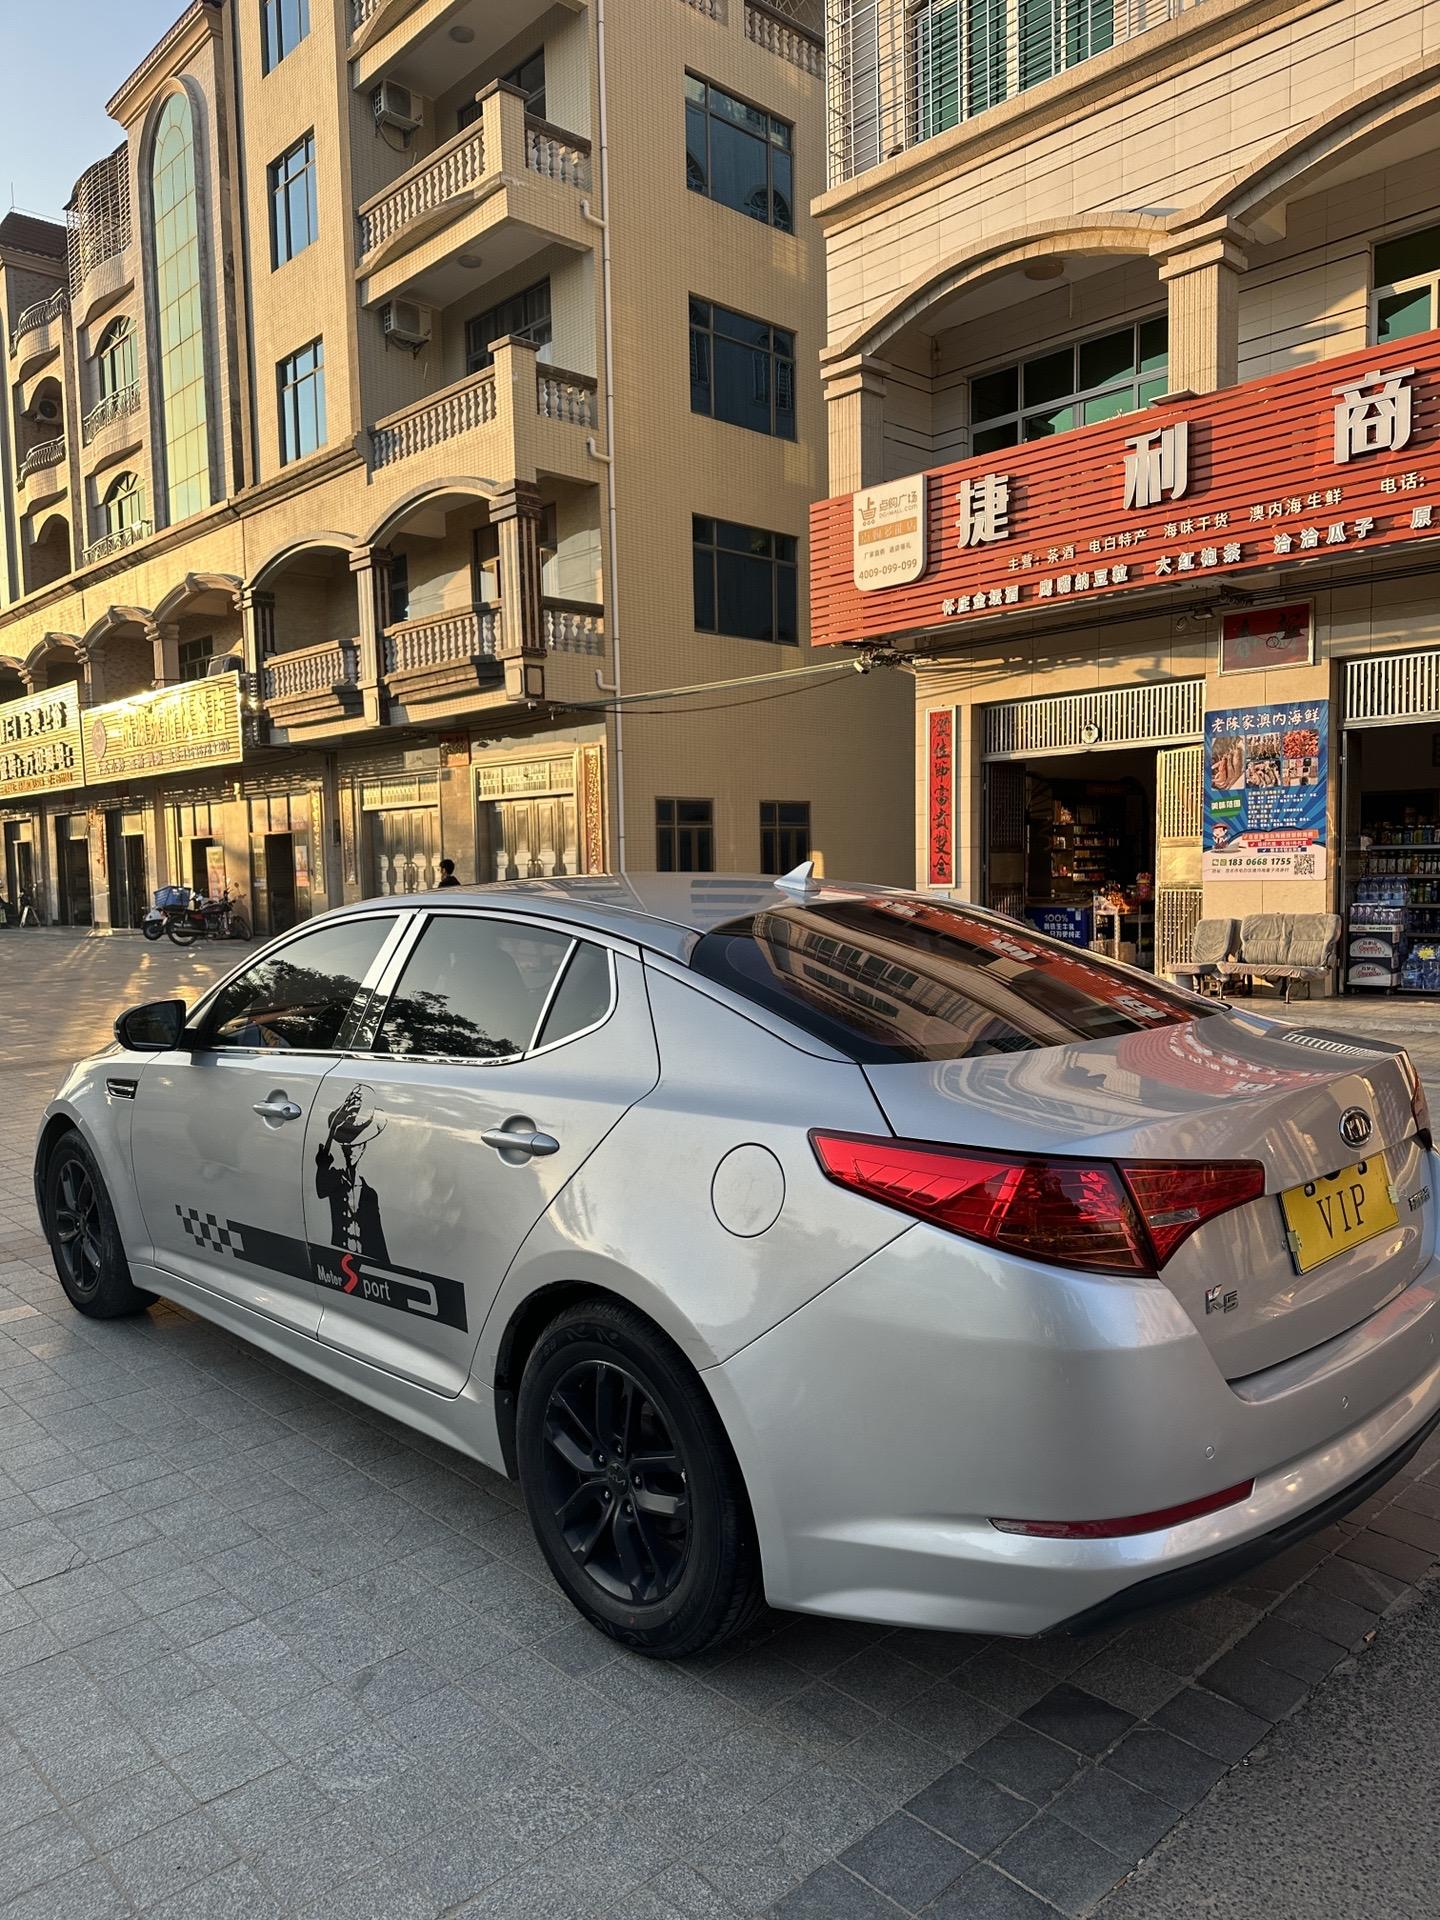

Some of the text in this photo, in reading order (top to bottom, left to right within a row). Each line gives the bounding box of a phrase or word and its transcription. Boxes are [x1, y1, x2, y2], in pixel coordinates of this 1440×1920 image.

[1089, 529, 1148, 554] 电白特产
[1163, 512, 1230, 539] 海味干货
[1249, 488, 1342, 523] 澳内海生鲜
[1155, 543, 1241, 576] 大红袍茶
[1273, 516, 1374, 555] 洽洽瓜子
[1410, 505, 1433, 529] 原
[859, 558, 918, 580] 4009-099-099
[1211, 708, 1320, 733] 老陈家澳内海鲜
[1228, 857, 1291, 866] 183 0668 1755
[1316, 1182, 1367, 1239] VIP
[1205, 1284, 1240, 1314] K5
